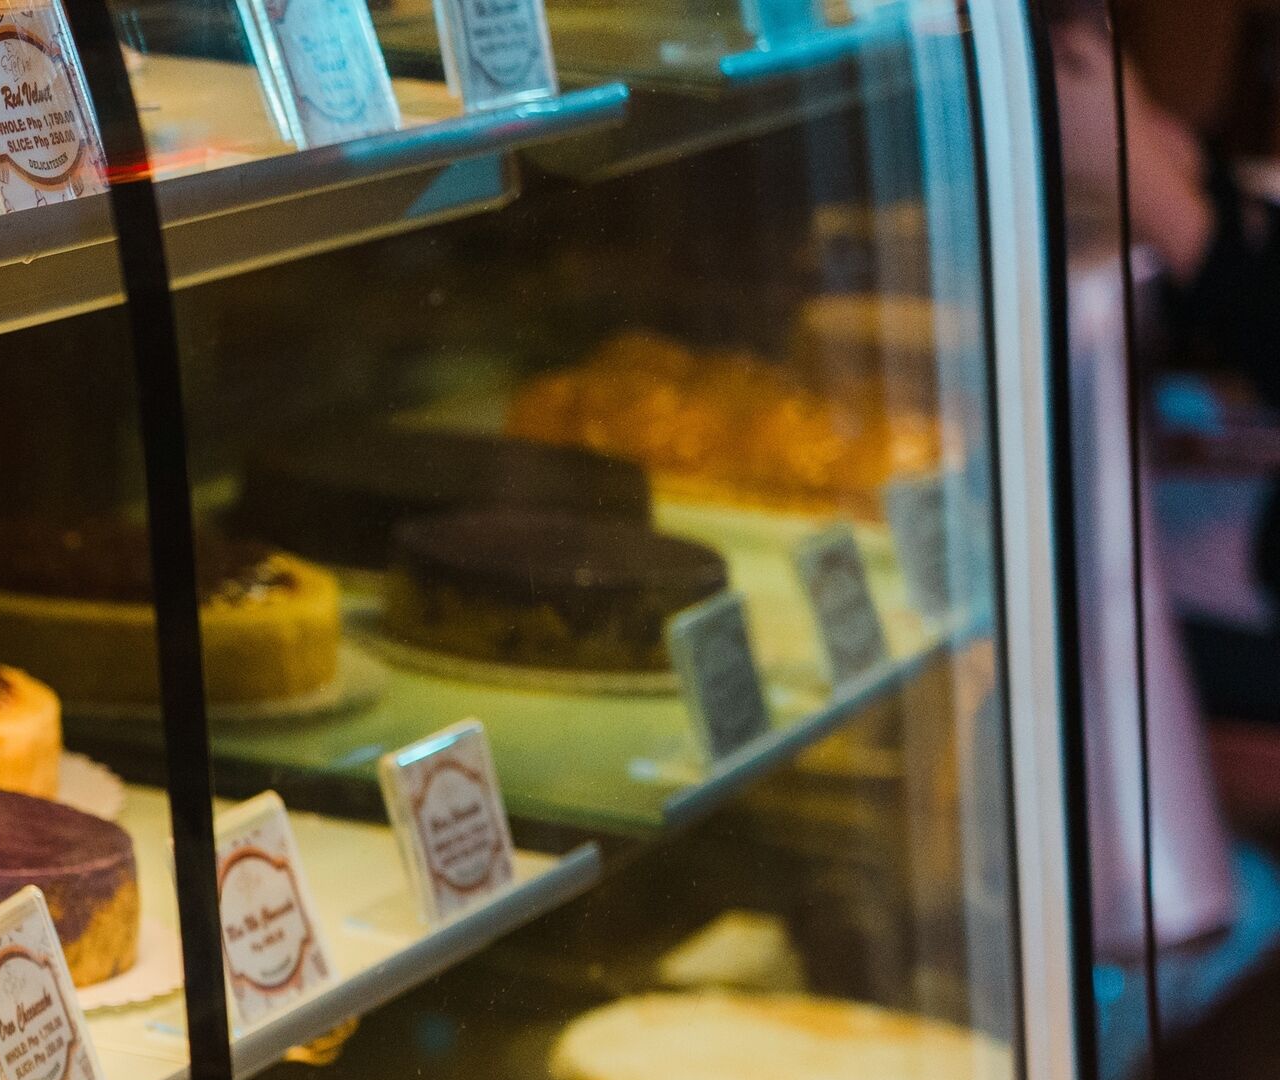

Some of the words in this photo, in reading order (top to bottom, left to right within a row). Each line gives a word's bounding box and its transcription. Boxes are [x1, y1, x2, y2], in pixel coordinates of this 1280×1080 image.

[0, 84, 24, 110] Red
[22, 81, 53, 106] Velvet
[26, 116, 43, 132] Php
[43, 110, 75, 129] 1,750.00
[7, 137, 34, 153] SLICE:
[33, 134, 50, 150] Php
[49, 129, 75, 146] 250.00
[28, 152, 68, 170] DELICATESSEN
